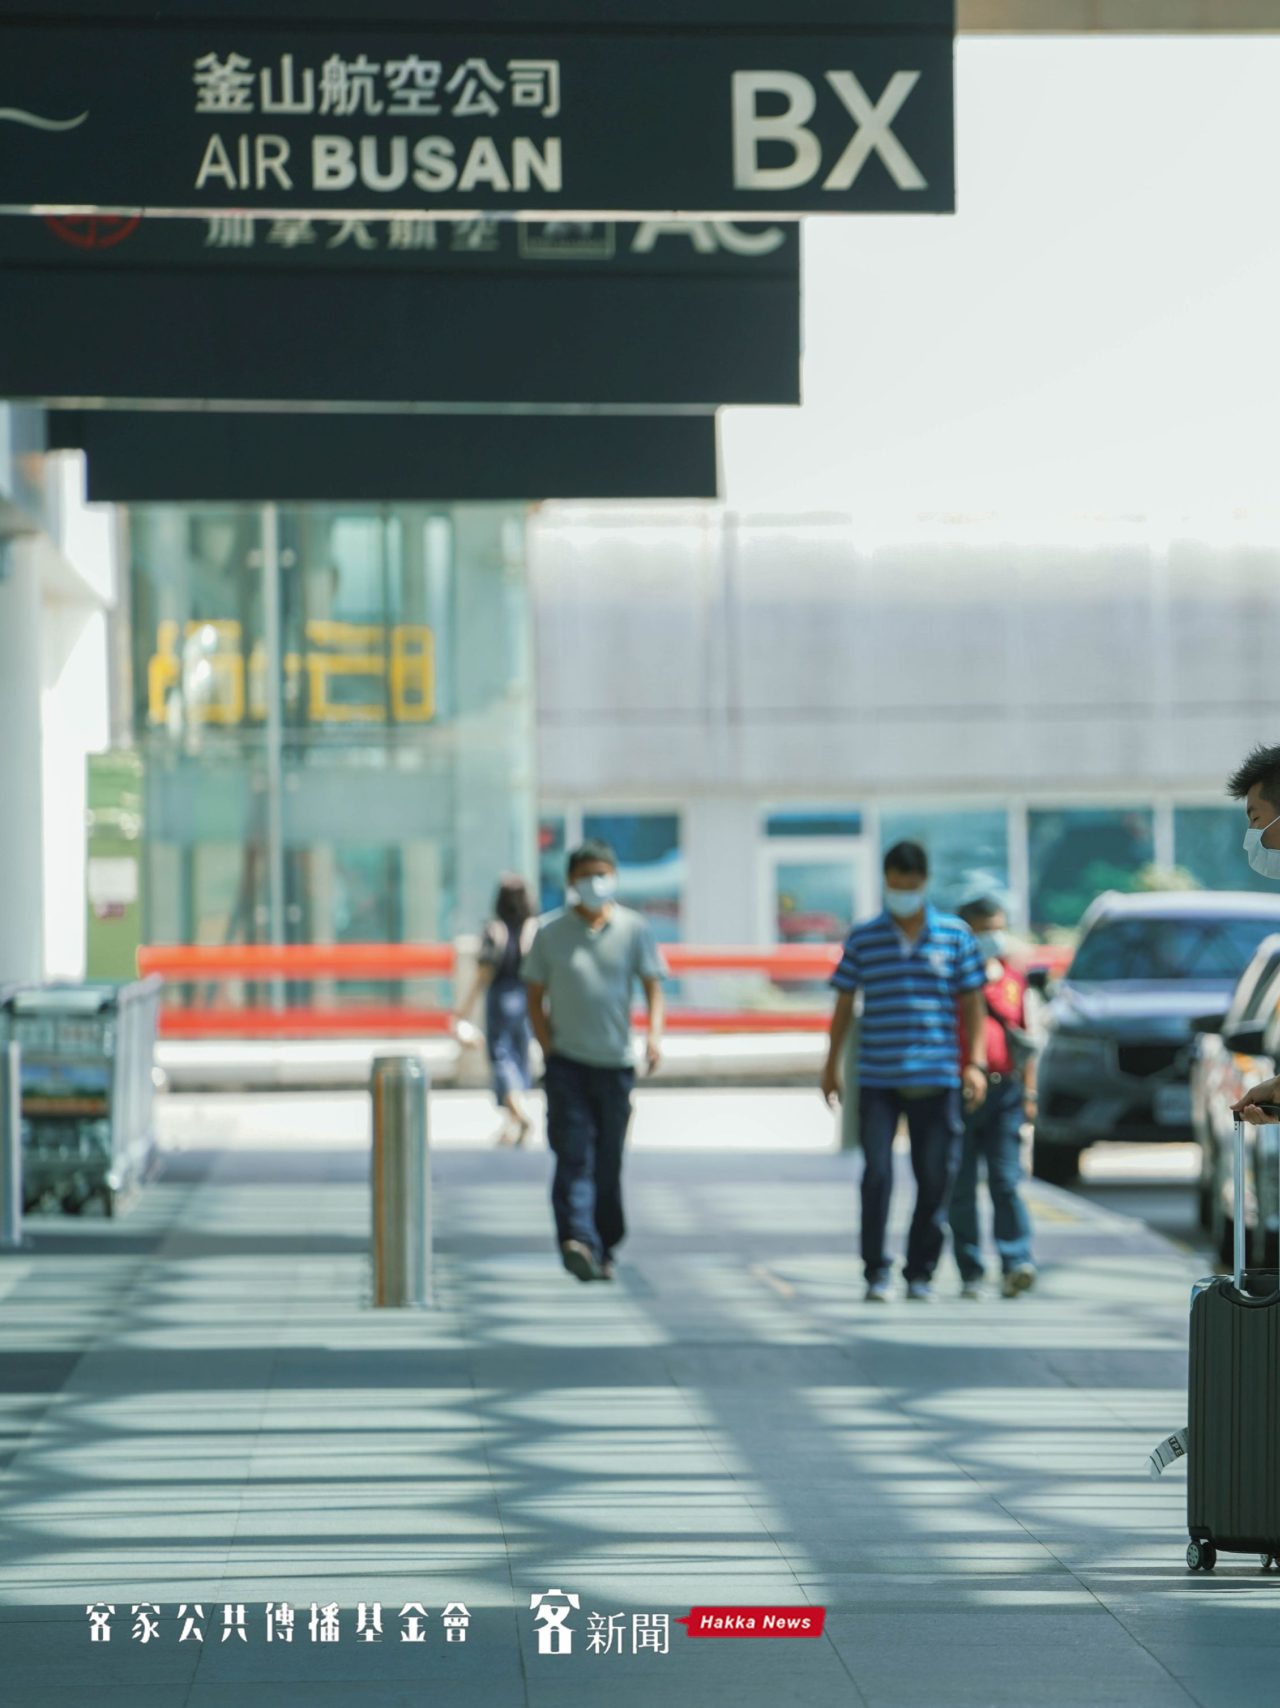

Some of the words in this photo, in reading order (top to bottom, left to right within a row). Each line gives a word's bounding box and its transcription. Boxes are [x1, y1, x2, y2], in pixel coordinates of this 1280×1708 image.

[193, 52, 561, 118] 釜山航空公司
[731, 70, 929, 191] BX
[195, 133, 293, 190] AIR
[311, 135, 562, 193] BUSAN
[1168, 1436, 1184, 1457] TPE
